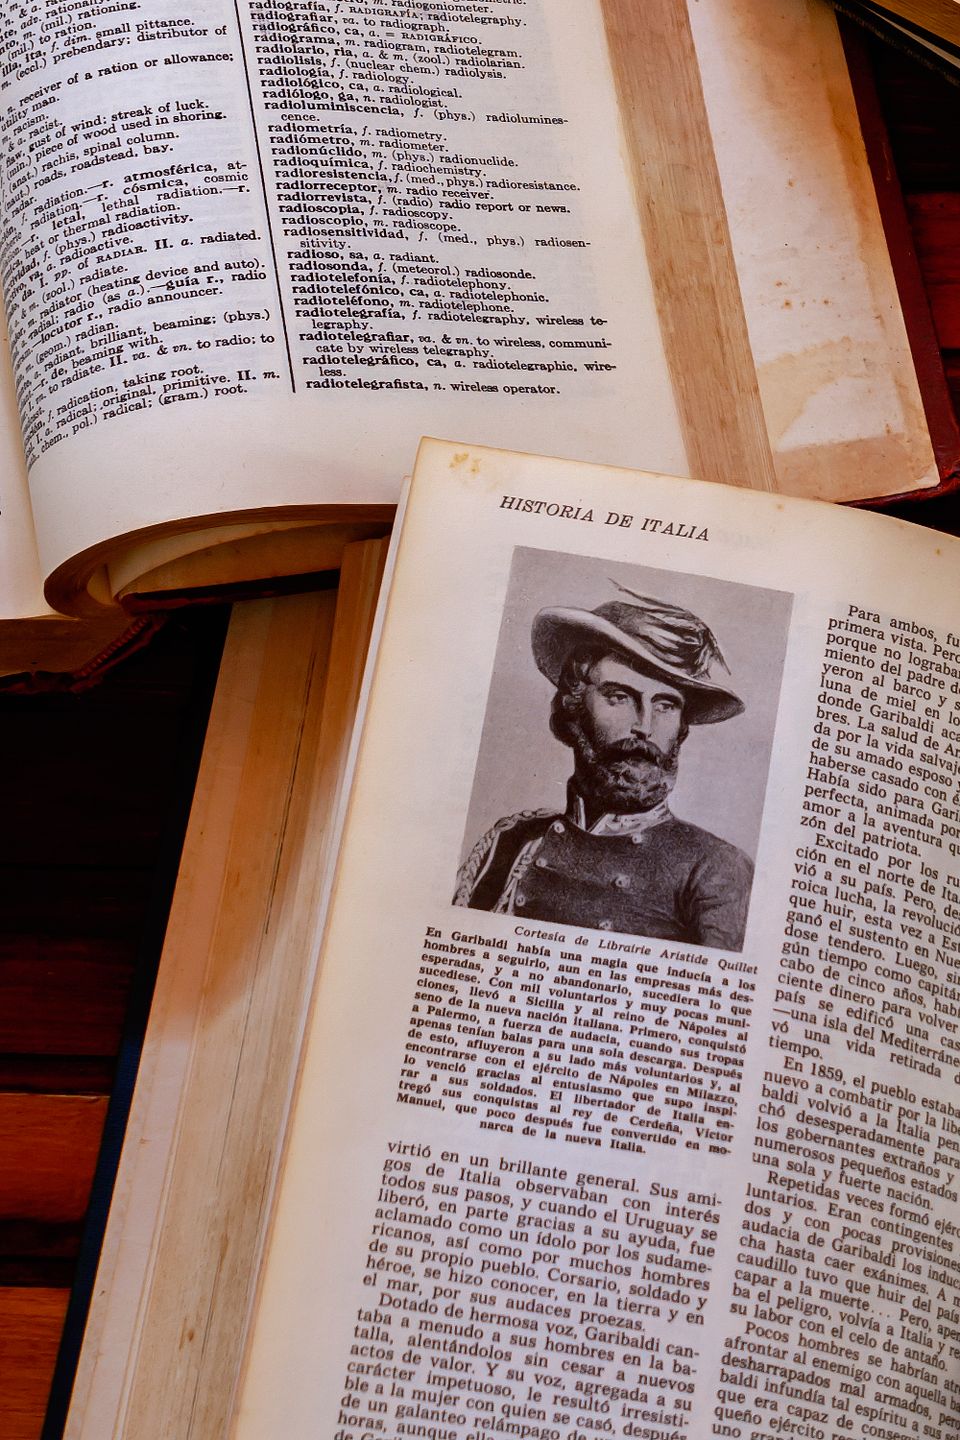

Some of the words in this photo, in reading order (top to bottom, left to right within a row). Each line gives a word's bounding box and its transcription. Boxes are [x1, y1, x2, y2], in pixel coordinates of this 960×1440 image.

[258, 65, 335, 81] radiología,
[351, 70, 414, 88] radiology.
[276, 188, 374, 208] radiorrevista,
[392, 194, 434, 210] (radio)
[438, 198, 471, 210] radio
[474, 202, 514, 213] report
[518, 204, 532, 212] or
[535, 205, 571, 214] news.
[106, 298, 143, 315] radio
[147, 287, 223, 305] announcer.
[305, 377, 429, 392] radiotelegrafista,
[449, 380, 499, 393] wireless
[502, 384, 561, 396] operator.
[499, 495, 594, 523] HISTORIA
[604, 511, 634, 528] DE
[640, 517, 709, 542] ITALIA
[514, 925, 566, 943] Cortesía
[574, 935, 589, 947] de
[597, 938, 652, 956] Librairie
[659, 949, 709, 966] Aristide
[717, 958, 758, 975] Quillet
[387, 1140, 432, 1159] virtió
[440, 1151, 459, 1164] en
[469, 1155, 489, 1168] un
[498, 1156, 568, 1181] brillante
[575, 1172, 640, 1193] general.
[649, 1182, 679, 1200] Sus
[686, 1192, 722, 1207] ami-
[362, 1272, 378, 1287] el
[386, 1278, 423, 1297] mar,
[431, 1286, 461, 1305] por
[469, 1292, 497, 1306] sus
[505, 1298, 572, 1319] audaces
[578, 1310, 646, 1337] proezas.
